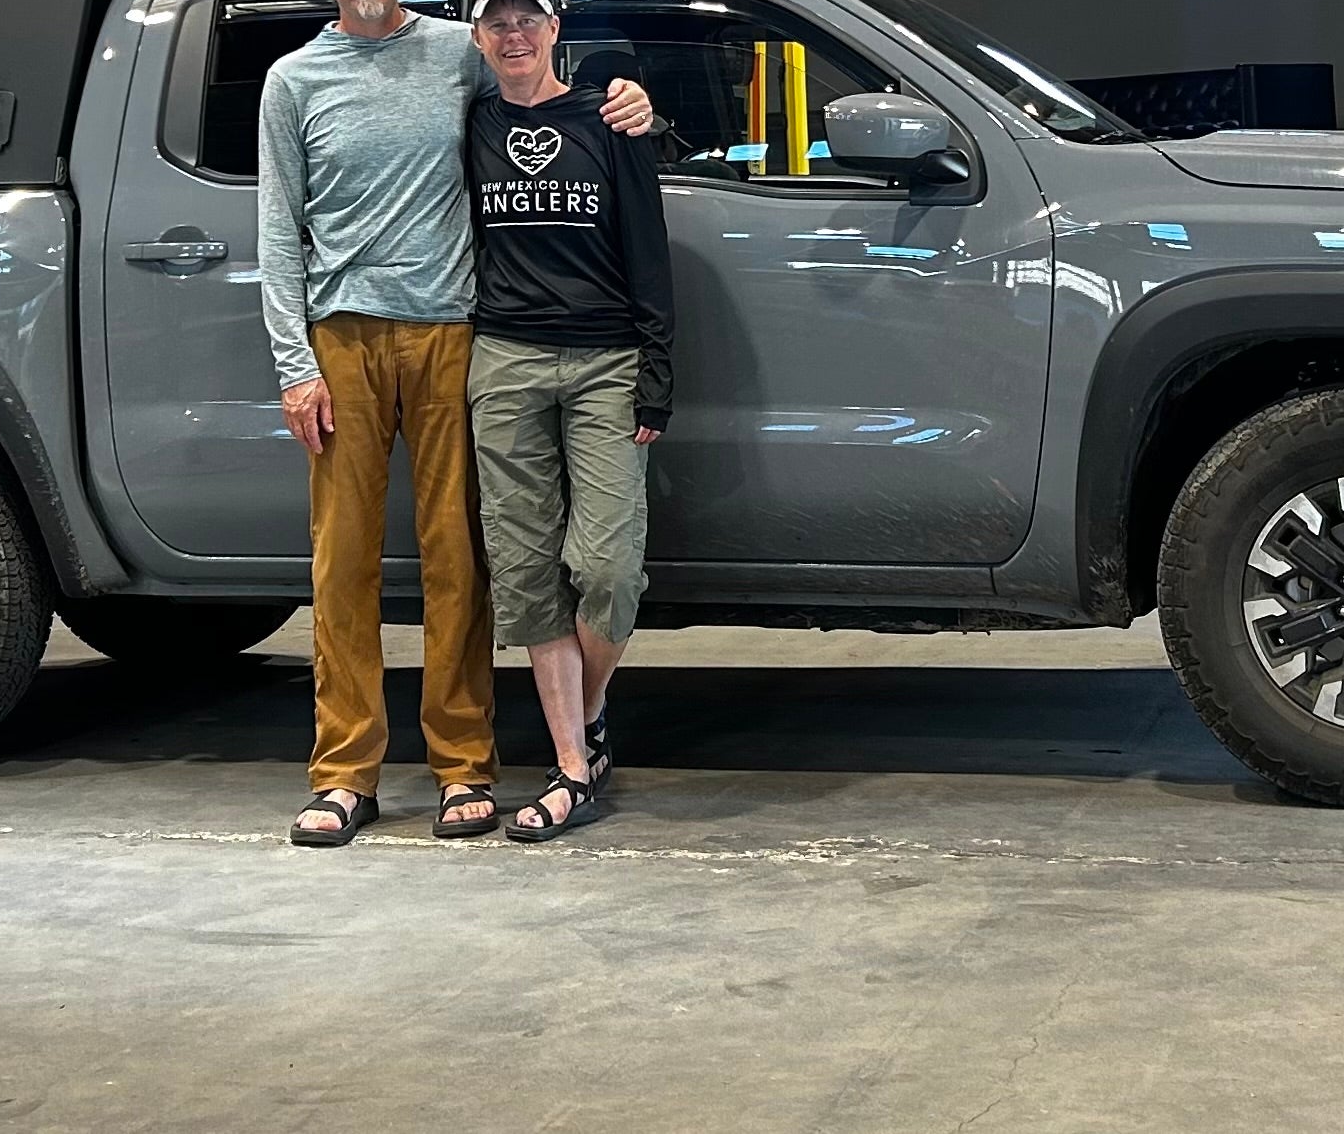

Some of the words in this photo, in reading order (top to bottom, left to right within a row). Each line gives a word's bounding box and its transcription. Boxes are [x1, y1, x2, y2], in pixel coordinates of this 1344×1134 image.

[481, 181, 502, 194] NEW
[506, 179, 559, 192] MEXICO
[565, 180, 600, 194] LADY
[482, 192, 600, 215] ANGLERS
